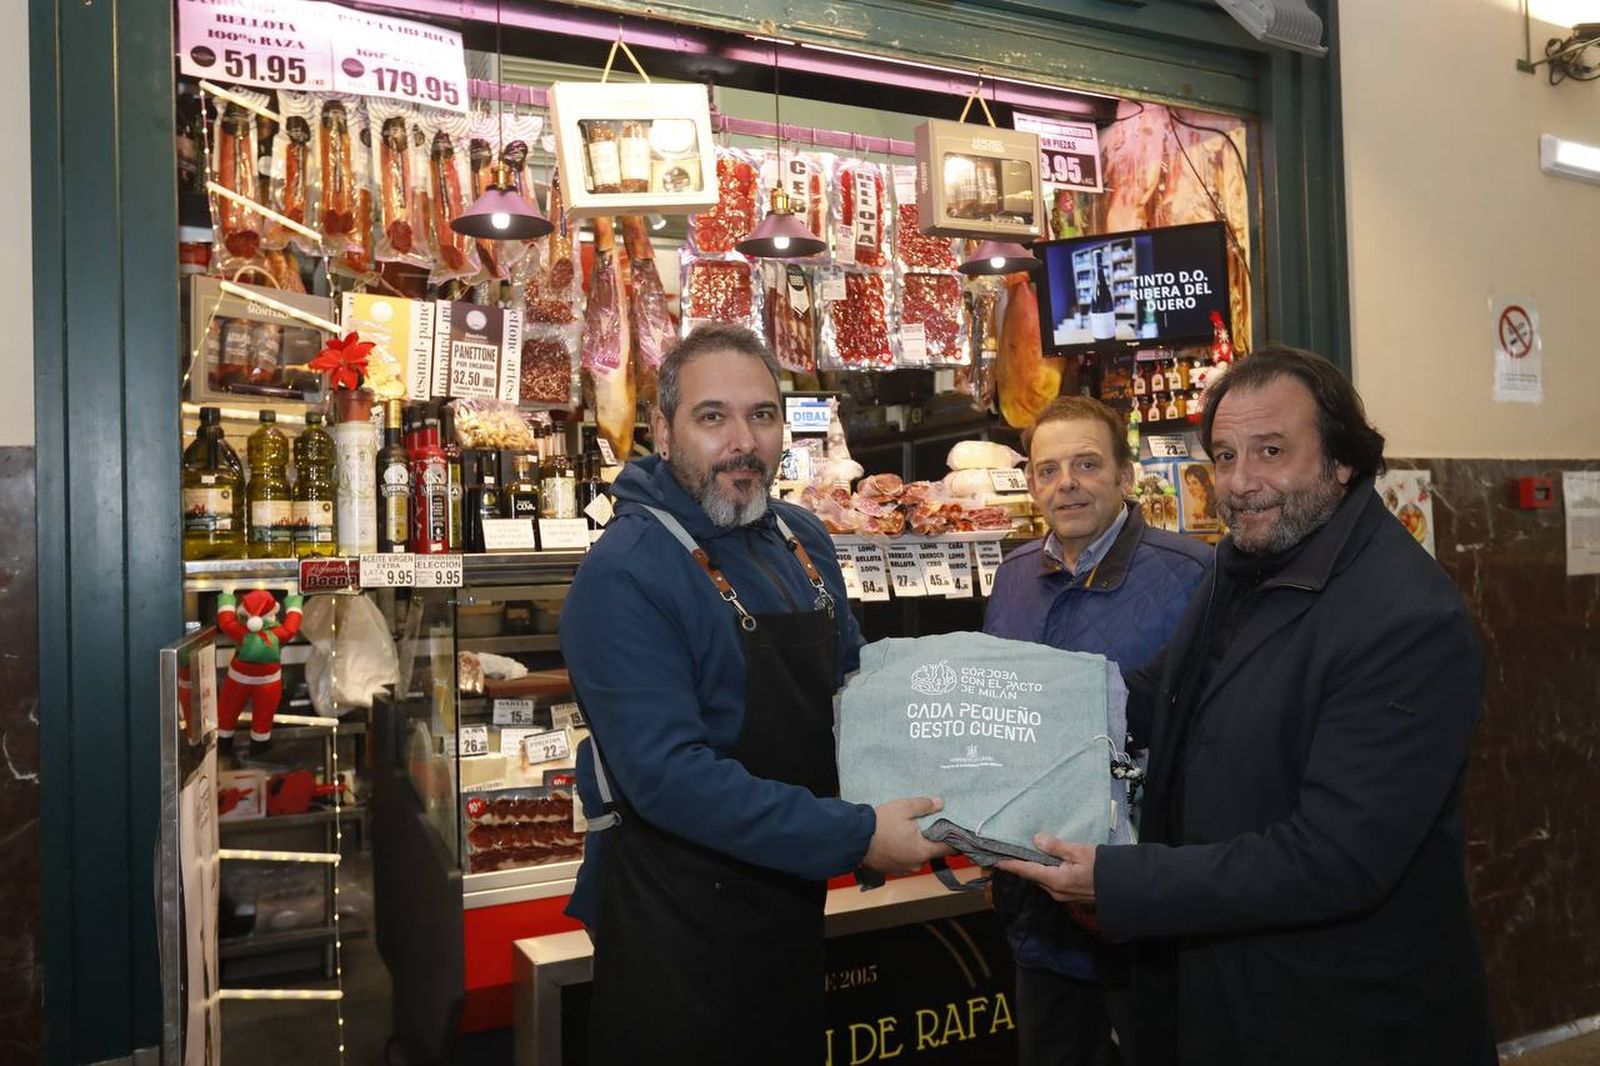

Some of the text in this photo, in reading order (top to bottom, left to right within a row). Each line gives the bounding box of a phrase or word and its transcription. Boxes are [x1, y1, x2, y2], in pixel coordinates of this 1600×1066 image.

[215, 13, 297, 32] BELLOTA
[207, 29, 305, 49] 100% RAZA
[224, 49, 306, 84] 51.95
[371, 67, 459, 105] 179.95
[1053, 139, 1077, 151] PIEZAS
[857, 172, 875, 245] BELLOTA
[1130, 269, 1208, 288] TINTO D.O.
[1130, 282, 1212, 301] RIBERA DEL
[1146, 297, 1196, 311] DUERO
[453, 343, 496, 363] PANETTONE
[453, 369, 480, 386] 32.50
[793, 411, 829, 422] DIBAL
[858, 543, 876, 552] LOMO
[948, 552, 966, 560] LOMO
[890, 560, 916, 568] BELLOTA
[387, 570, 413, 585] 9.95
[435, 570, 461, 585] 9.95
[961, 675, 1042, 692] CON EL PACTO
[979, 687, 1017, 700] MILÁN
[907, 702, 1041, 726] CADA PEQUEÑO
[909, 720, 1037, 743] GESTO CUENTA
[839, 965, 878, 989] 2015
[848, 1016, 904, 1066] DE
[915, 992, 1016, 1051] RAFA
